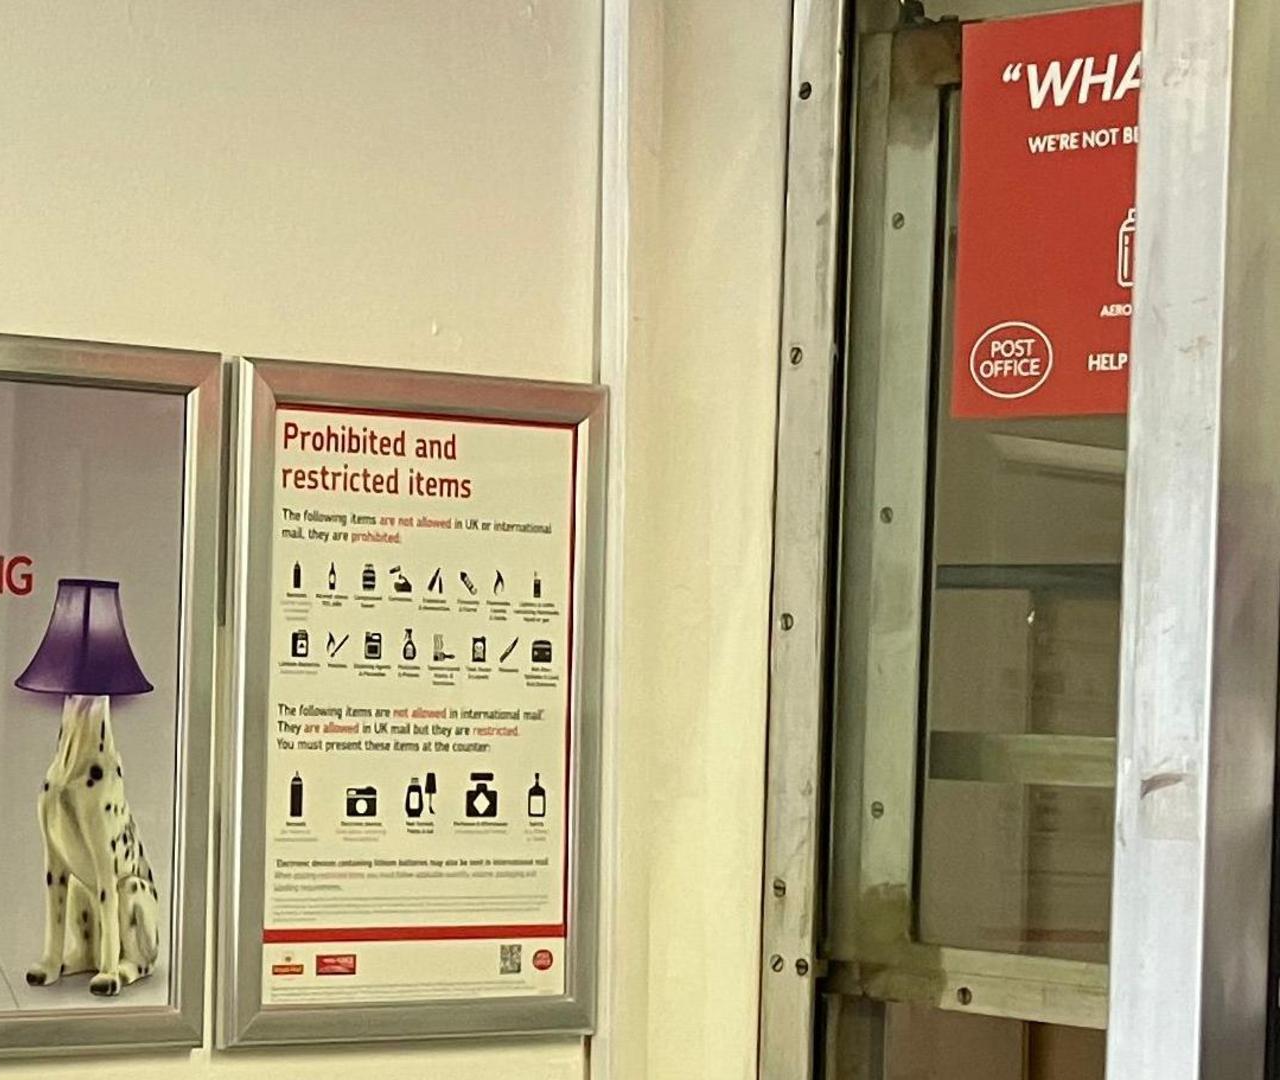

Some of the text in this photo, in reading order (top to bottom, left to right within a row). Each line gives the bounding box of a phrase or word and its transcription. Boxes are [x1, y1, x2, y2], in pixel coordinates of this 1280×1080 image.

[1028, 132, 1078, 154] WE'RE
[1082, 128, 1120, 148] NOT
[990, 339, 1035, 358] POST
[979, 358, 1041, 378] OFFICE
[1087, 354, 1128, 372] HELP
[283, 422, 457, 461] Prohibited and
[281, 464, 472, 499] restricted items
[282, 508, 552, 534] The following items are not allowed in UK or international
[308, 528, 329, 542] they
[332, 531, 348, 541] are
[277, 703, 296, 717] The
[298, 703, 343, 720] following
[345, 704, 372, 718] items
[374, 707, 391, 718] are
[392, 705, 409, 718] not
[411, 706, 447, 719] allowed
[449, 706, 458, 719] in
[460, 707, 520, 720] international
[277, 720, 302, 735] They
[303, 723, 320, 733] are
[322, 721, 360, 734] allowed
[362, 722, 371, 734] in
[374, 722, 388, 734] UK
[390, 723, 411, 735] mail
[413, 723, 429, 735] but
[431, 723, 452, 737] they
[454, 726, 470, 736] are
[276, 738, 294, 750] You
[297, 739, 323, 750] must
[325, 739, 362, 752] present
[364, 740, 391, 751] these
[393, 740, 420, 751] items
[422, 740, 432, 751] at
[434, 741, 450, 751] the
